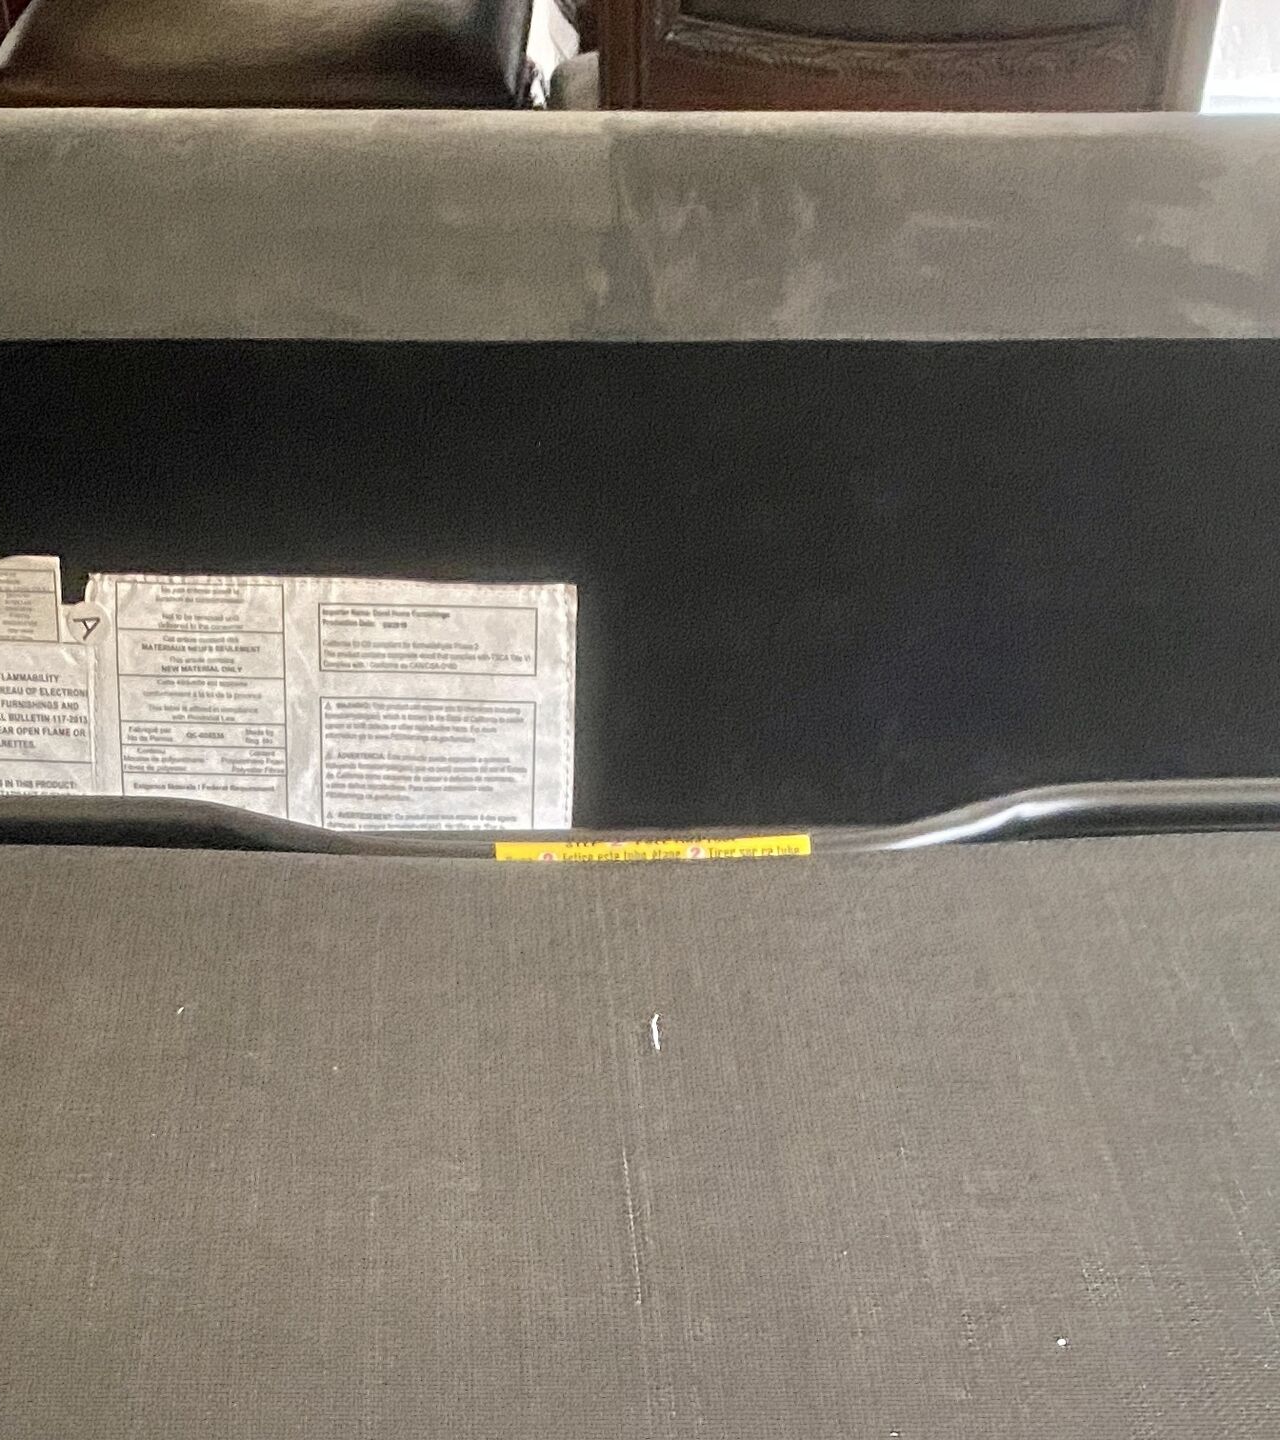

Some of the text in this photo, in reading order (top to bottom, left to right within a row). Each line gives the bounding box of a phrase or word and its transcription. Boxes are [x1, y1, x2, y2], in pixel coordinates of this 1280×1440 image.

[26, 686, 37, 695] OF
[1, 700, 58, 710] FURNISHINGS
[62, 701, 78, 711] AND
[8, 713, 50, 723] BULLETIN
[16, 727, 40, 736] OPEN
[42, 727, 70, 737] FLAME
[73, 728, 85, 737] OR
[6, 779, 13, 788] IN
[16, 779, 33, 788] THIS
